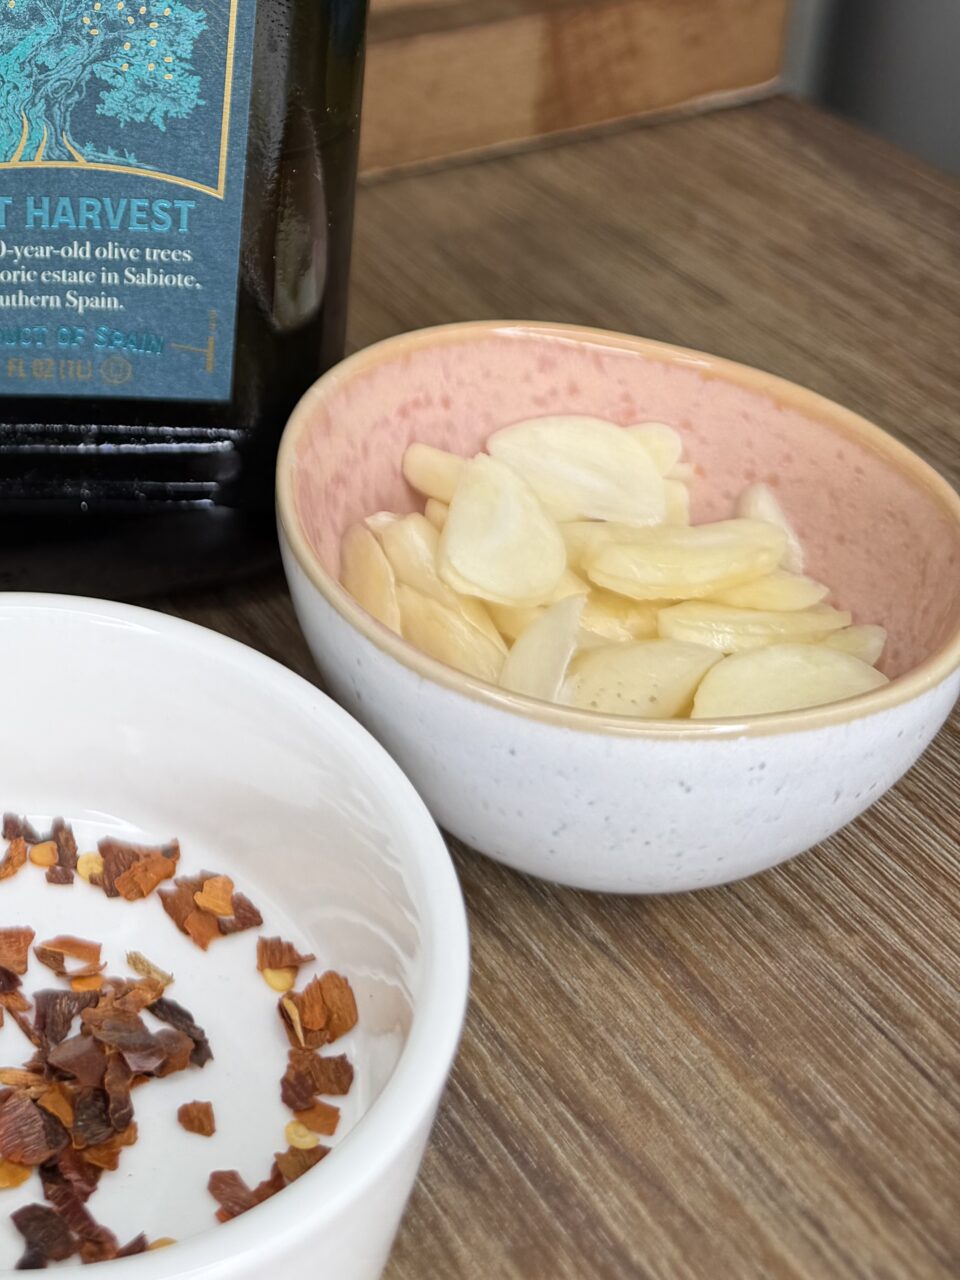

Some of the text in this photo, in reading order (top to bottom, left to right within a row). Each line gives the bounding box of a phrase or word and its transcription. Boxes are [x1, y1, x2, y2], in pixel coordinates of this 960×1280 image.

[25, 196, 196, 234] HARVEST
[95, 243, 141, 261] olive
[145, 246, 193, 263] trees
[40, 268, 97, 284] estate
[100, 267, 120, 285] in
[65, 291, 125, 313] Spain.
[57, 326, 85, 348] OF
